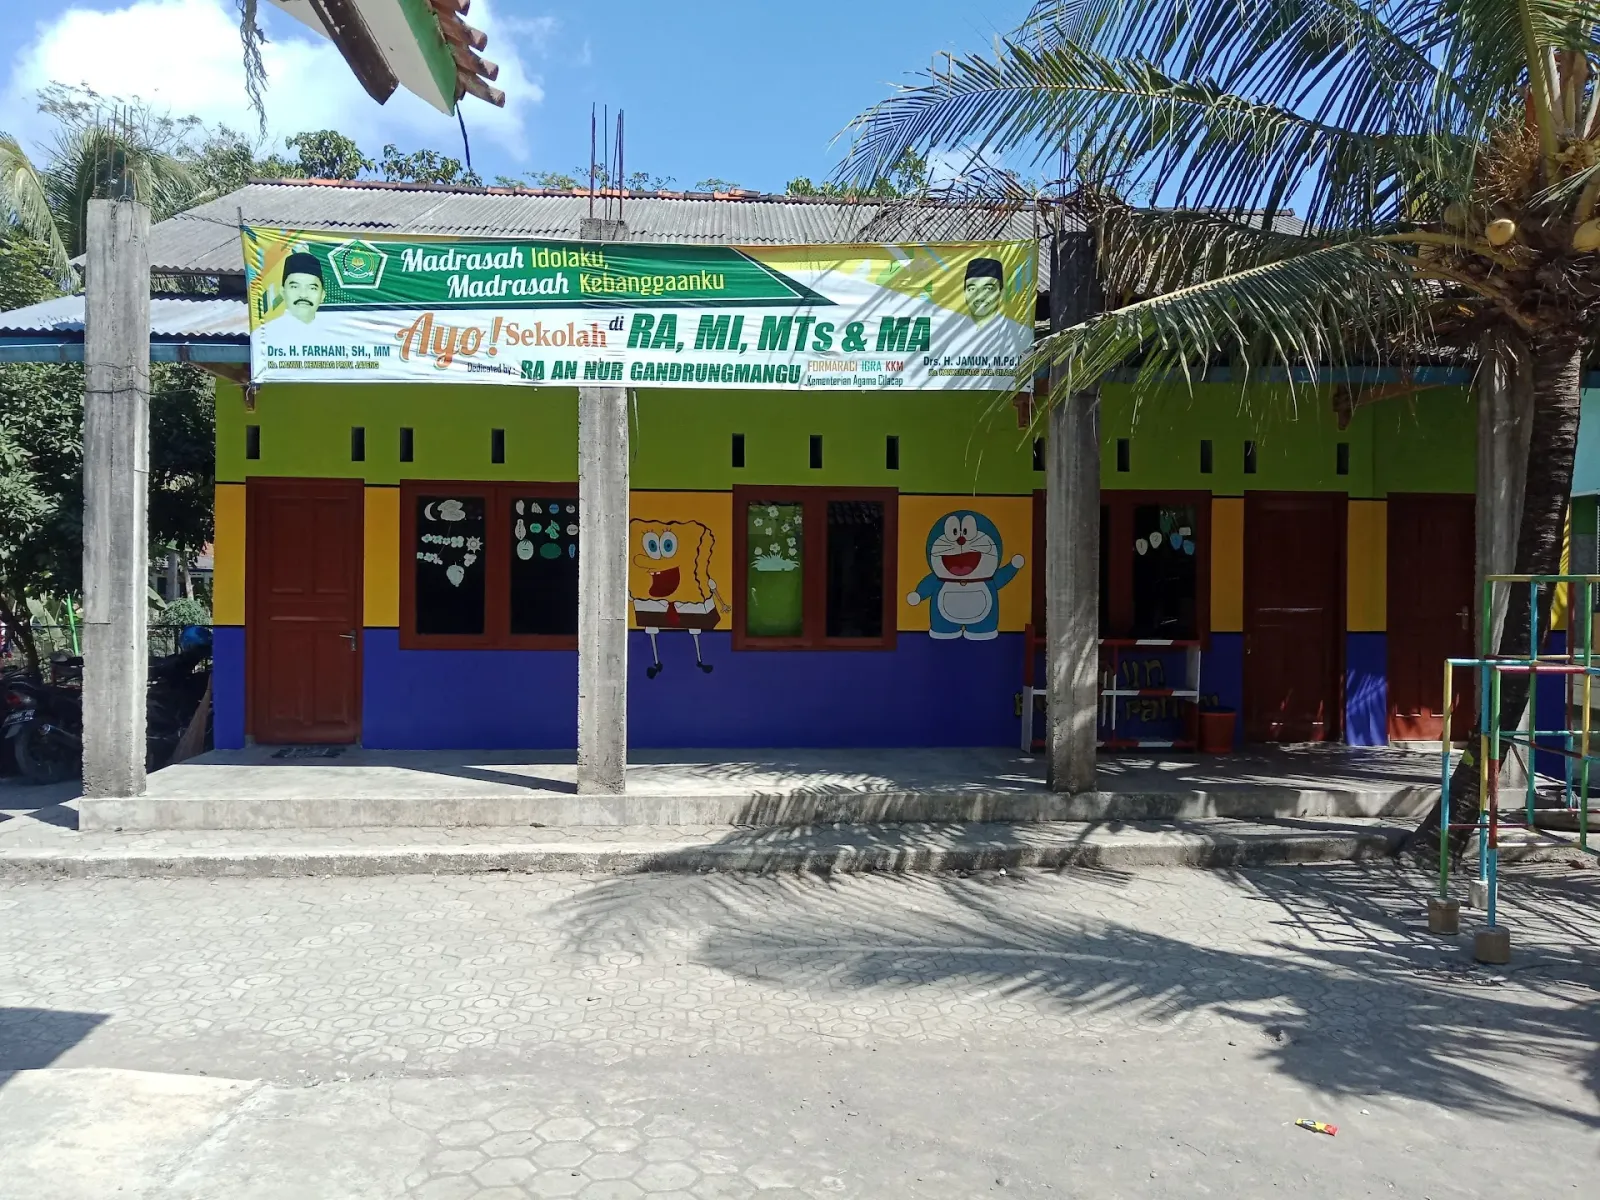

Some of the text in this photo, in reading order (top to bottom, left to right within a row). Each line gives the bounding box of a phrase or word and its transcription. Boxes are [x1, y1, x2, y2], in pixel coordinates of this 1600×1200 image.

[400, 246, 609, 273] Madrasah Idolaku,
[446, 270, 725, 298] Madrasah Kebanggaanku
[395, 311, 931, 370] Ayo! Sekolah di RA, MI, MTs & MA
[267, 345, 391, 359] Drs. H. FARHANI, SH., MM
[467, 362, 501, 374] Dedicated
[807, 360, 904, 372] FORMARACI IGRA KKM
[923, 356, 941, 366] Drs.
[943, 356, 953, 366] H.
[955, 356, 991, 368] JAMUN,
[520, 360, 802, 384] RA AN NUR GANDRUNGMANGU
[807, 374, 904, 388] Kementerian Agama Cilacap
